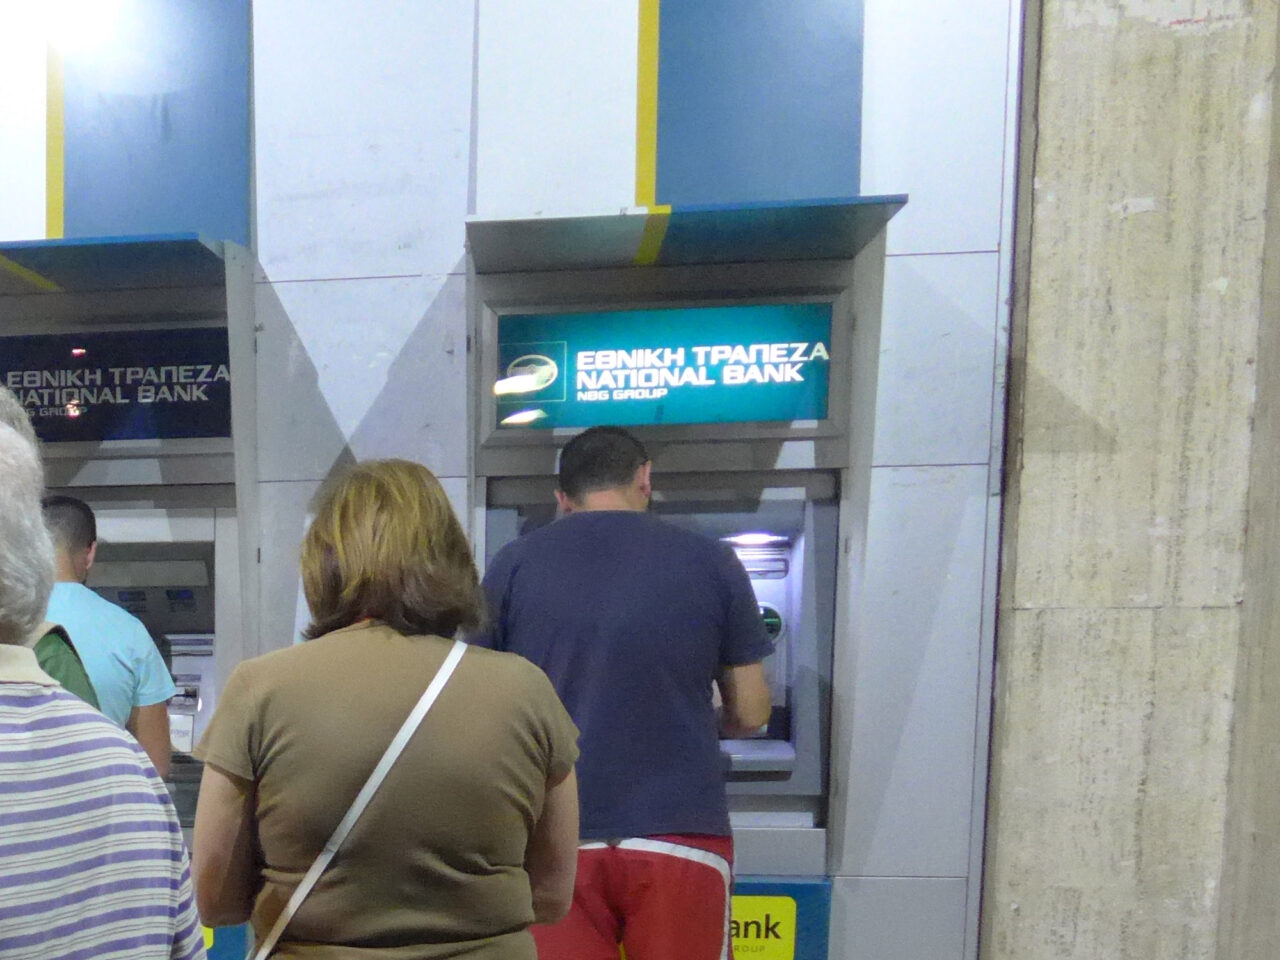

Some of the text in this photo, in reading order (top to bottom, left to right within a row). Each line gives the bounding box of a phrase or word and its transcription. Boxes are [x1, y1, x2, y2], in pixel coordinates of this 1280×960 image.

[692, 342, 829, 364] ΤΡΑΠΕΖΑ
[108, 364, 231, 386] ΤΡΑΠΕΖΑ
[576, 363, 805, 389] NATIONAL BANK
[137, 383, 209, 403] BANK
[576, 387, 669, 402] NBG GROUP
[730, 913, 783, 940] ank
[733, 944, 766, 953] ROUP
